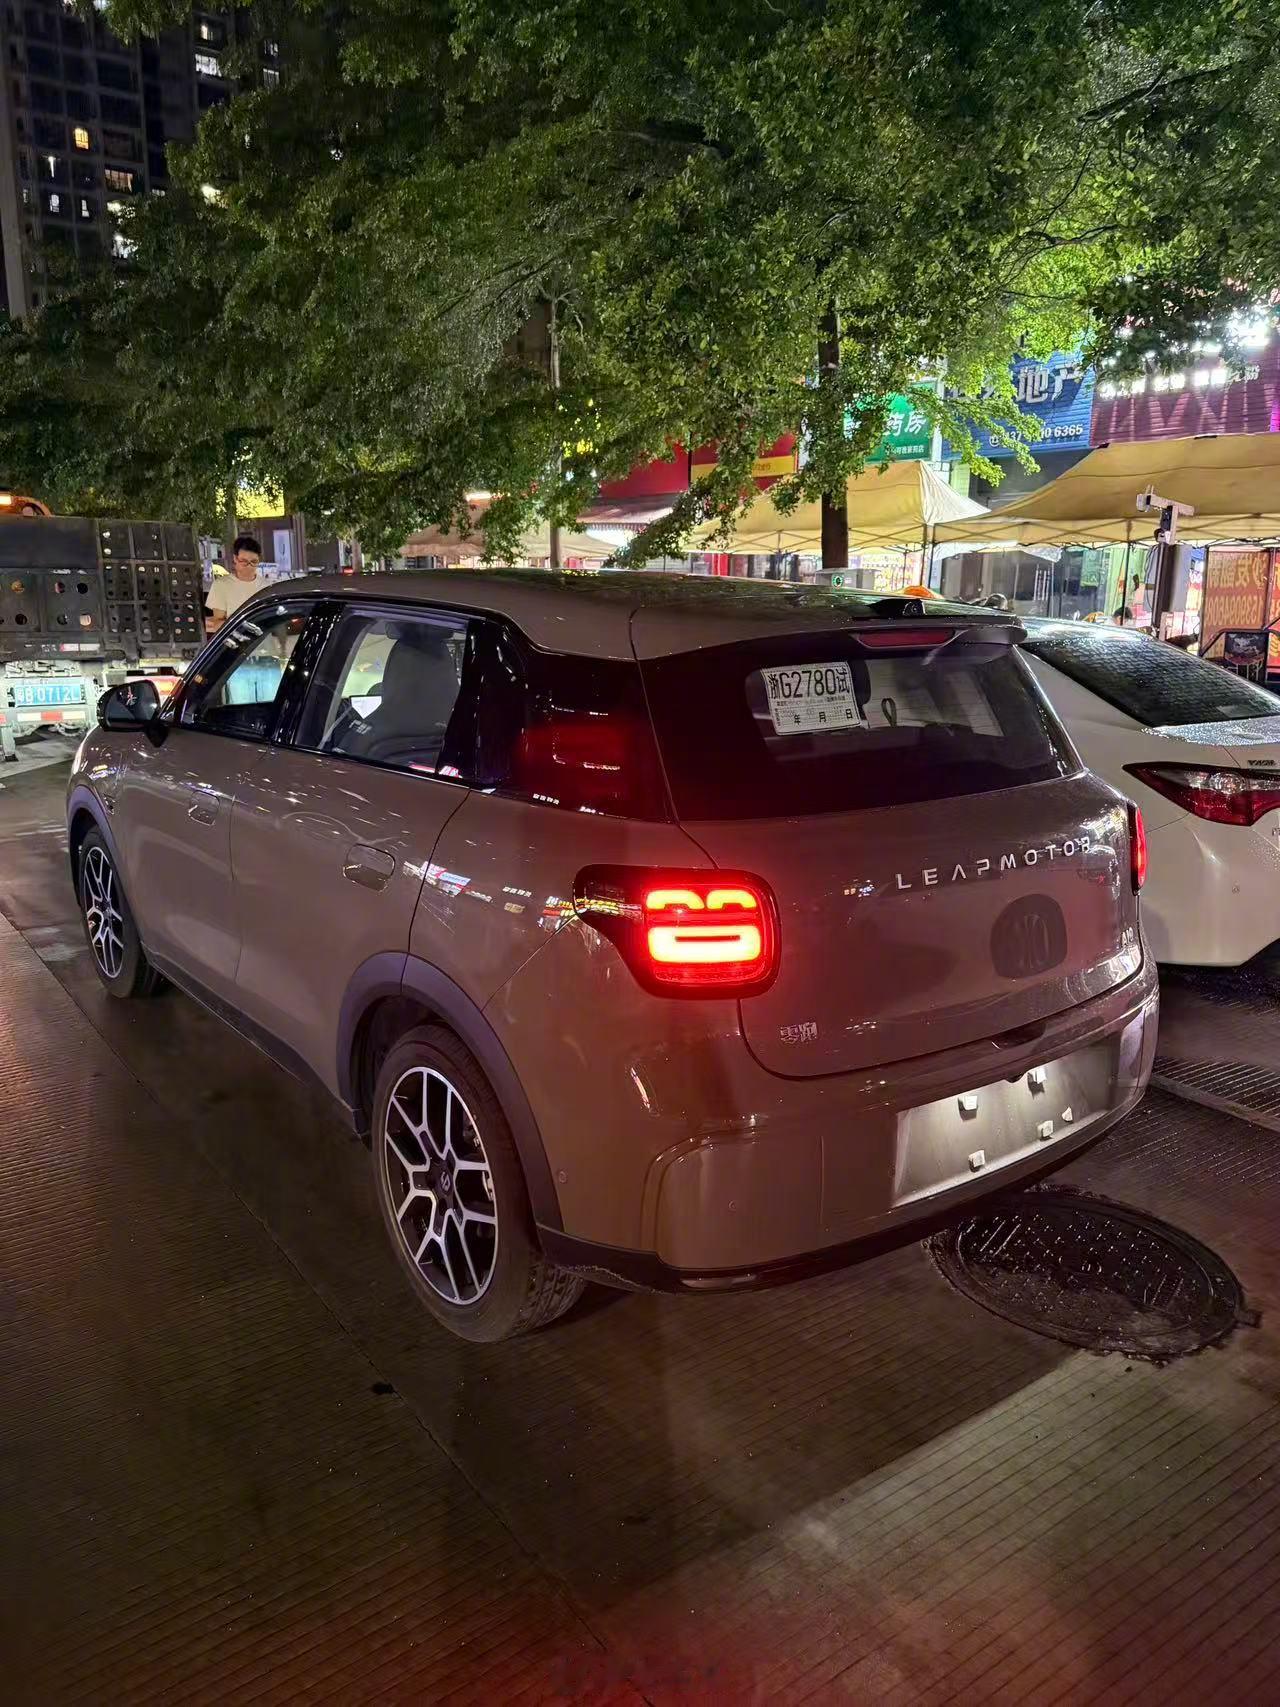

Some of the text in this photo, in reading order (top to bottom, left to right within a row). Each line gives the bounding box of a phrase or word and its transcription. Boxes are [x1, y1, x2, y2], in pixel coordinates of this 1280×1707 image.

[1054, 424, 1083, 438] 6365
[17, 685, 81, 704] B0712L
[794, 714, 801, 725] 年
[819, 711, 826, 723] 月
[845, 708, 853, 719] 日
[895, 836, 1090, 890] LEAPMOTOR
